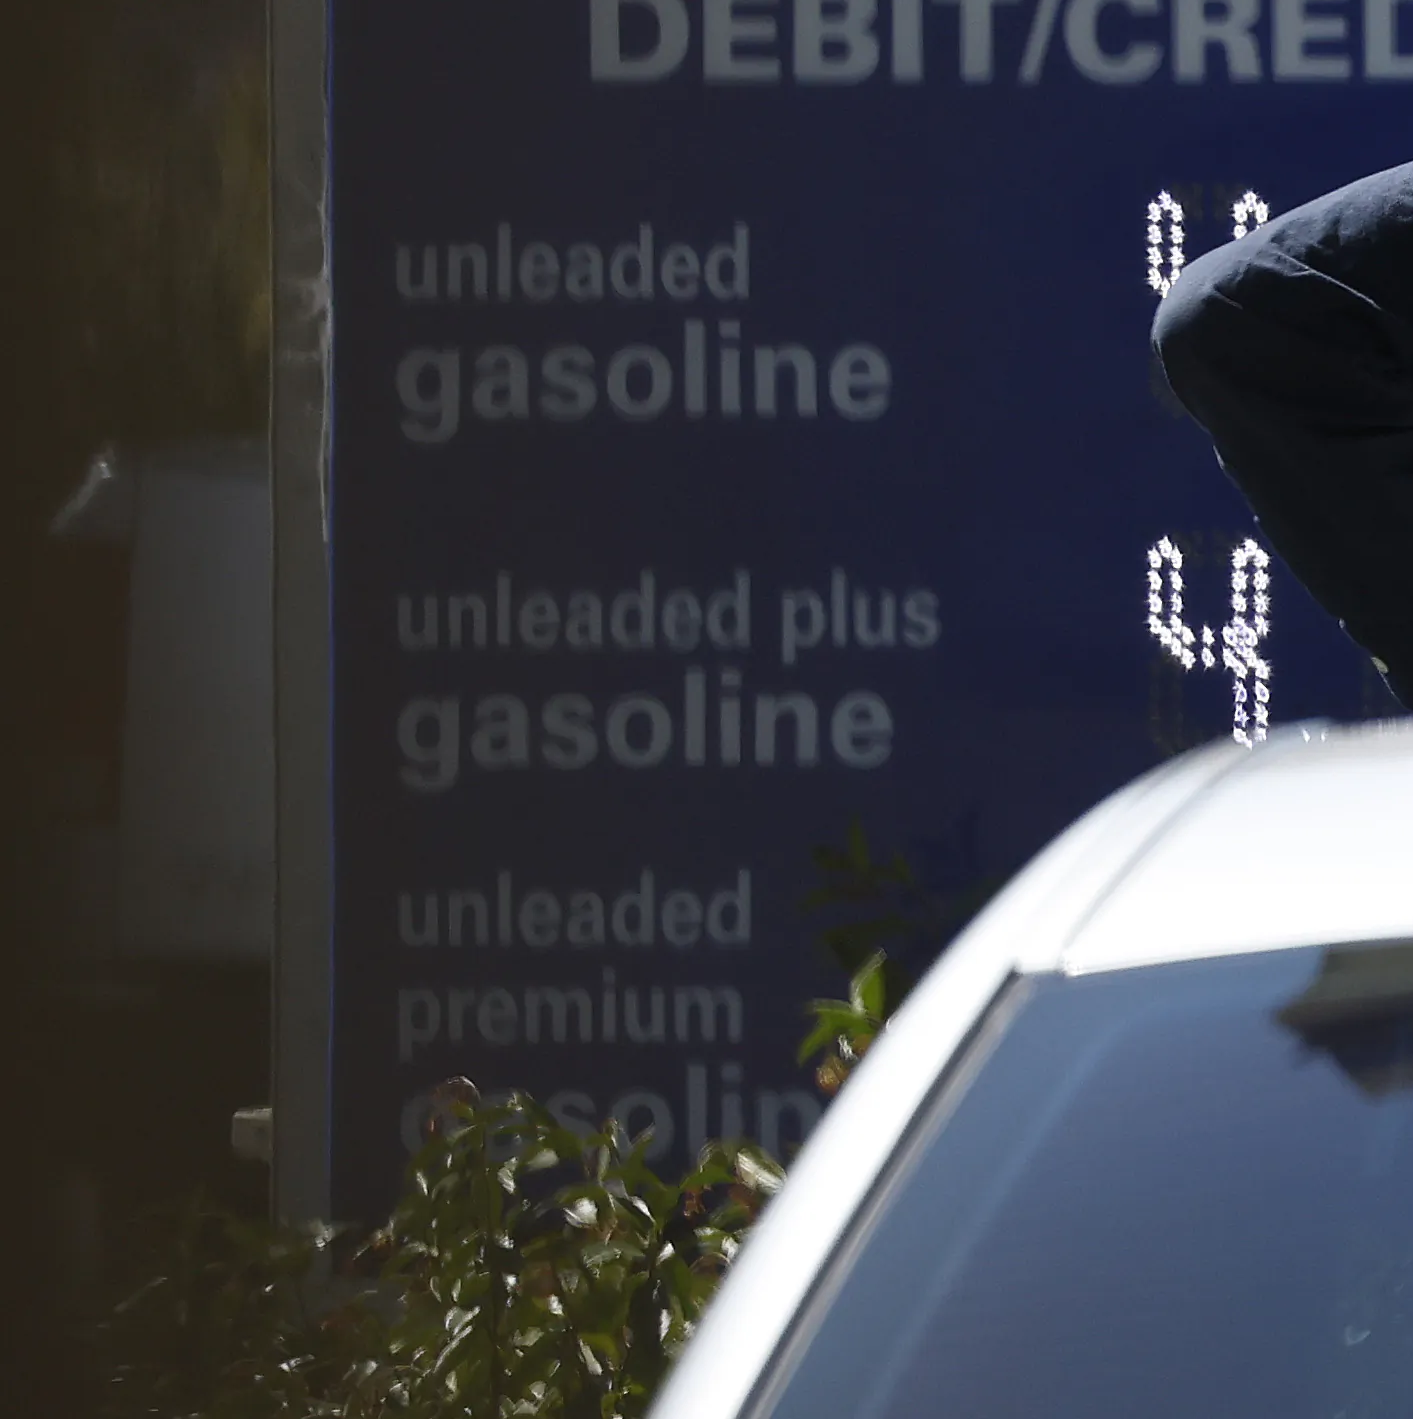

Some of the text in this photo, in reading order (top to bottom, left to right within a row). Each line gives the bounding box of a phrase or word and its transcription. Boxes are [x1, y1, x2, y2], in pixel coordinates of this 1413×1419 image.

[396, 221, 751, 301] unleaded
[397, 316, 893, 446] gasoline
[398, 568, 942, 667] unleaded plus
[398, 665, 895, 793] gasoline
[400, 868, 753, 949] unleaded
[400, 965, 743, 1065] premium
